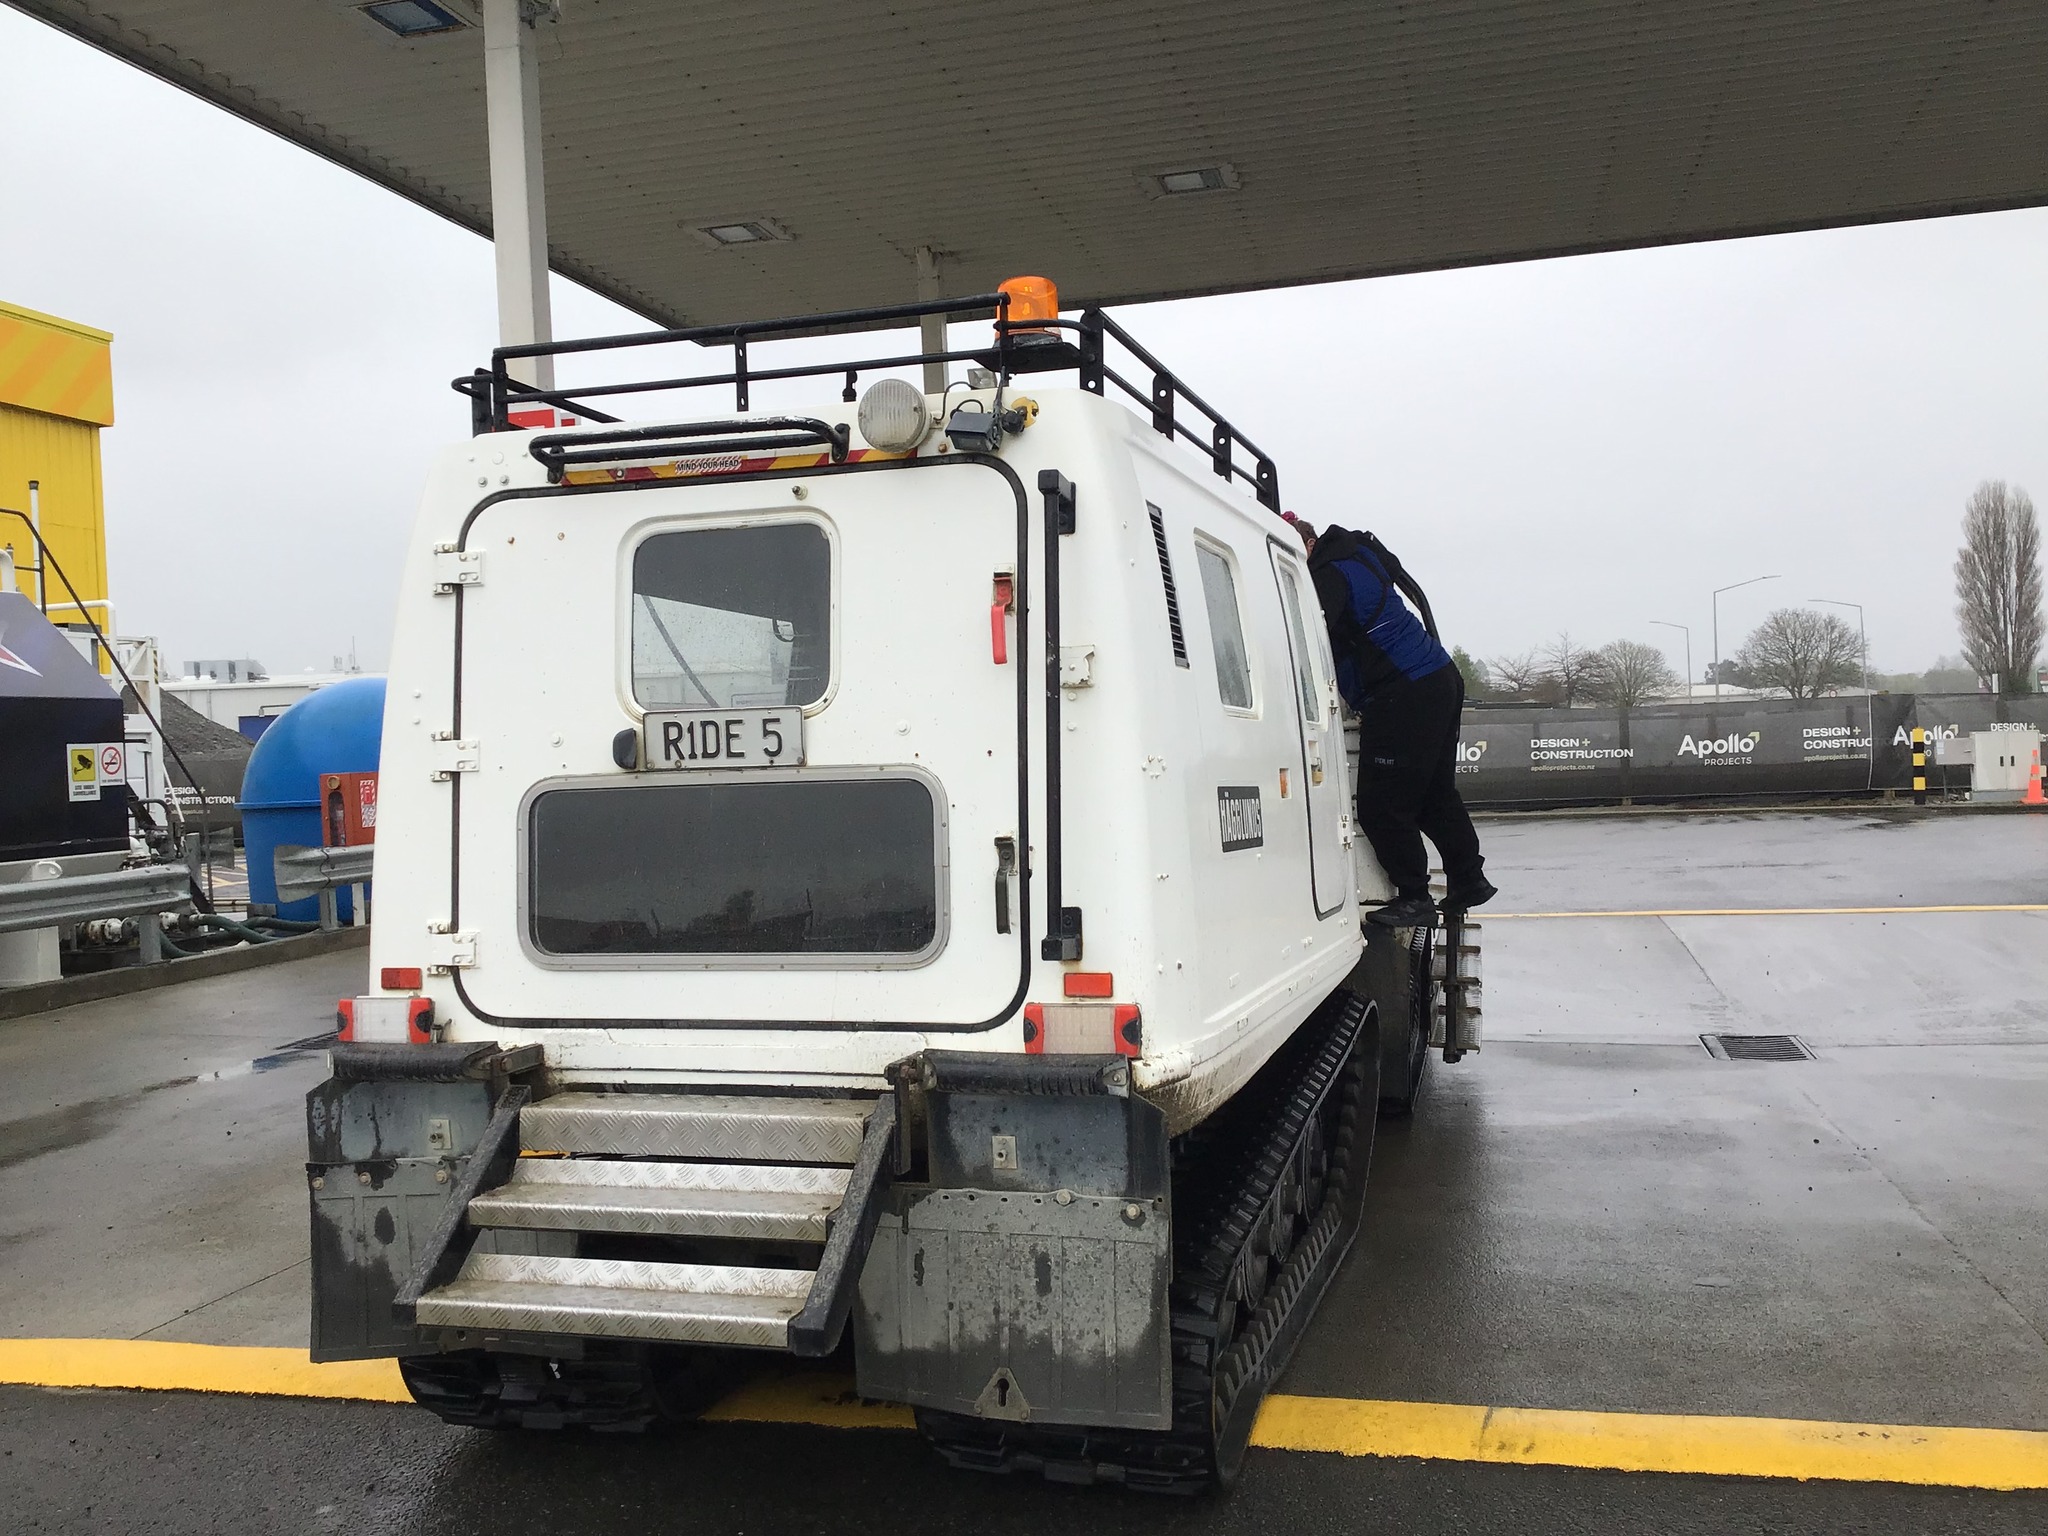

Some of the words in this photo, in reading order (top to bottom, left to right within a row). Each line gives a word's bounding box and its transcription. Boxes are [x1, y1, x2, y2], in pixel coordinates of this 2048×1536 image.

[677, 463, 696, 471] MIND
[699, 461, 718, 469] YOUR
[1990, 722, 2028, 731] DESIGN
[762, 718, 783, 757] 5
[1803, 727, 1851, 738] DESIGN
[1530, 738, 1580, 749] DESIGN
[1677, 732, 1755, 758] Apollo
[1803, 738, 1872, 750] CONSTRUC
[1456, 741, 1482, 762] llo
[1530, 749, 1634, 760] CONSTRUCTION
[1704, 757, 1752, 766] PROJECTS
[1456, 765, 1479, 773] ECTS
[165, 787, 198, 795] DESIGN
